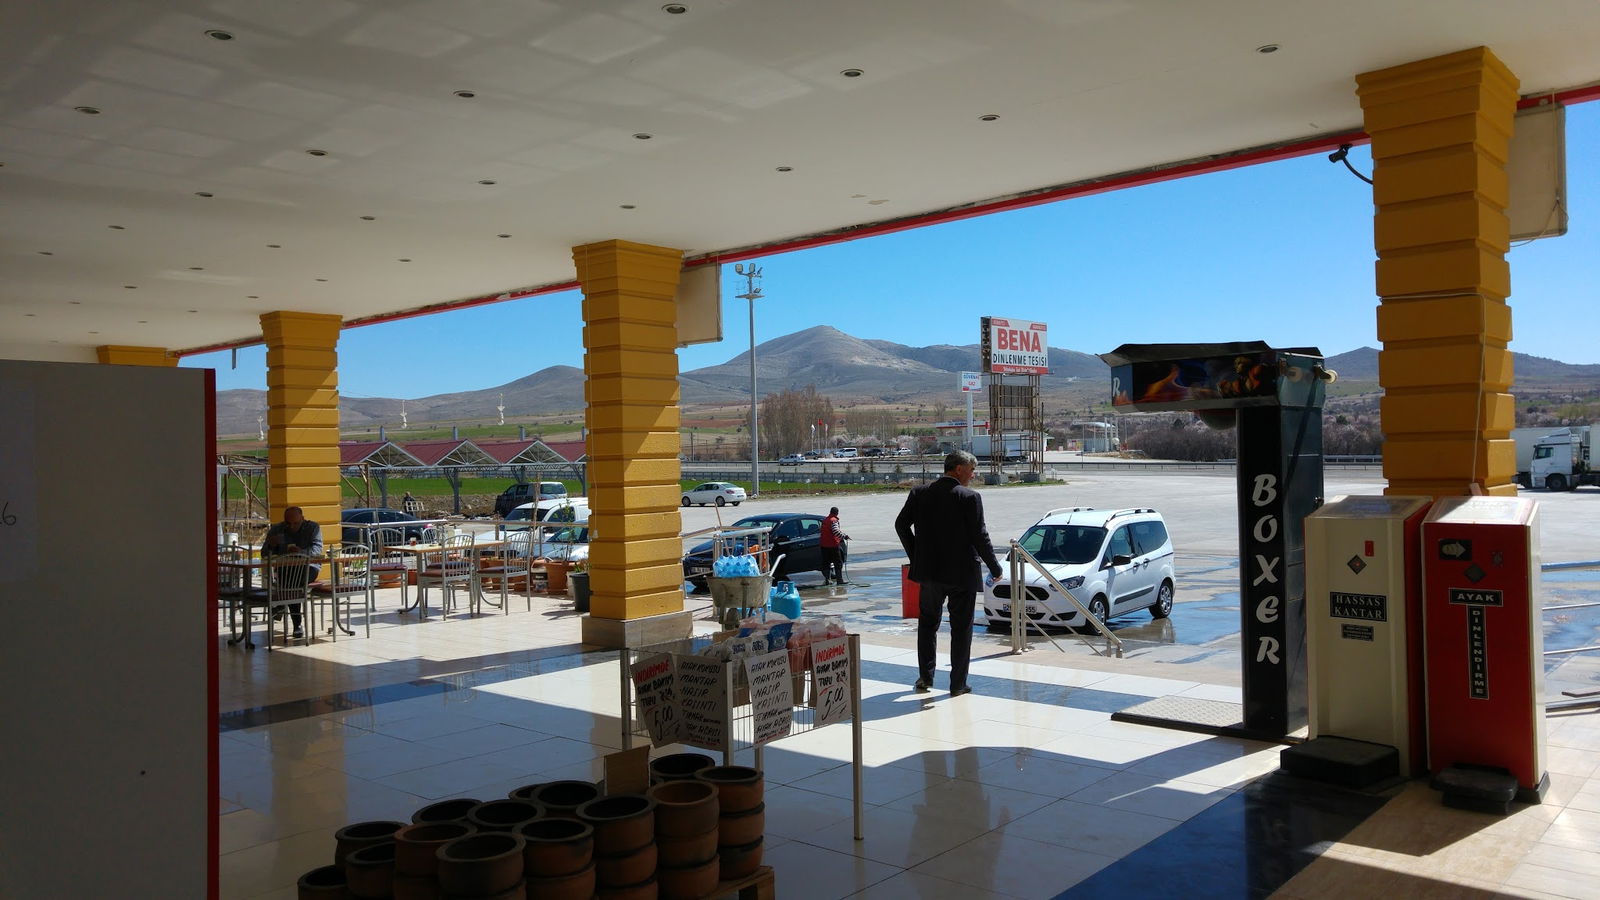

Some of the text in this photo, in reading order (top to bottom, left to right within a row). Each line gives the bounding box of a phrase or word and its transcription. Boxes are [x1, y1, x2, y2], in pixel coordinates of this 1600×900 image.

[998, 328, 1041, 352] BENA
[993, 352, 1047, 366] DİNLENME TESİSİ
[1335, 595, 1381, 606] HASSAS
[1457, 593, 1494, 602] AYAK
[1334, 606, 1382, 619] KANTAR
